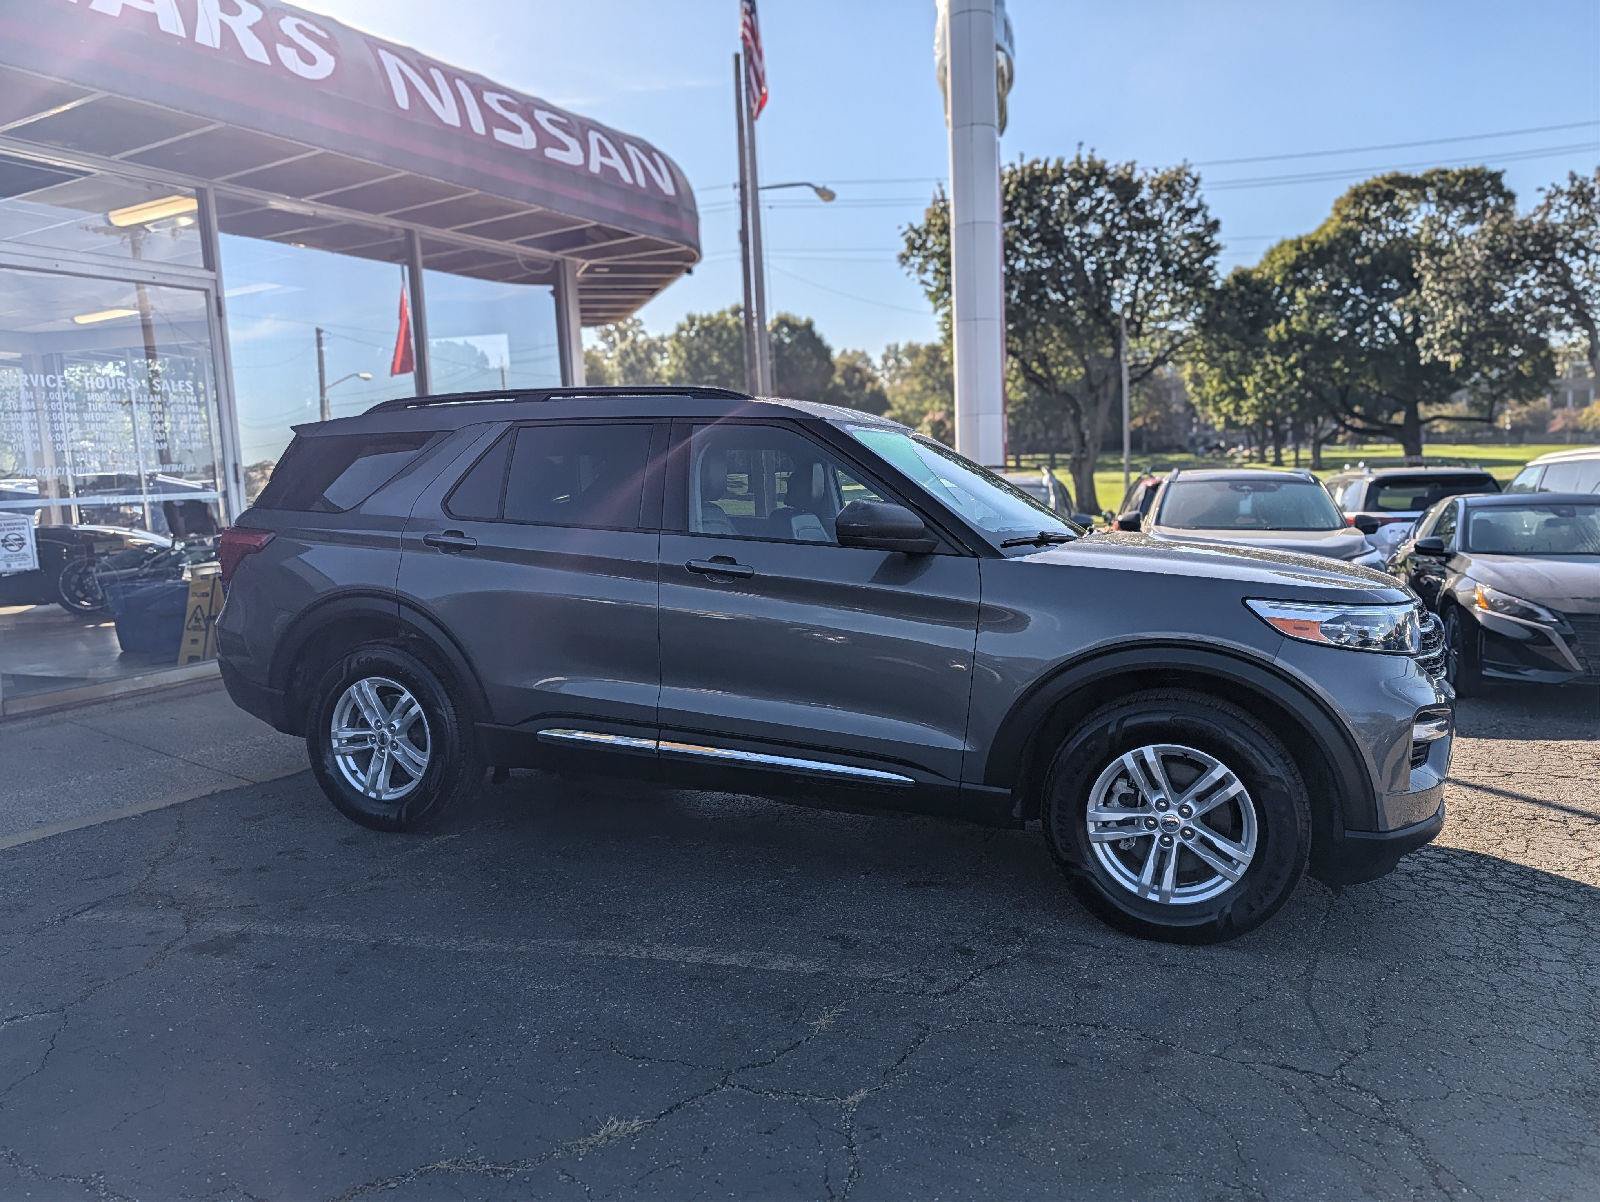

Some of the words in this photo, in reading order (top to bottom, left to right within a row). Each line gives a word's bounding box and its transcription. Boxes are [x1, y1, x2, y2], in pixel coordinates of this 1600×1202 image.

[378, 48, 676, 196] NISSAN
[84, 376, 135, 391] HOURS
[152, 379, 194, 393] SALES
